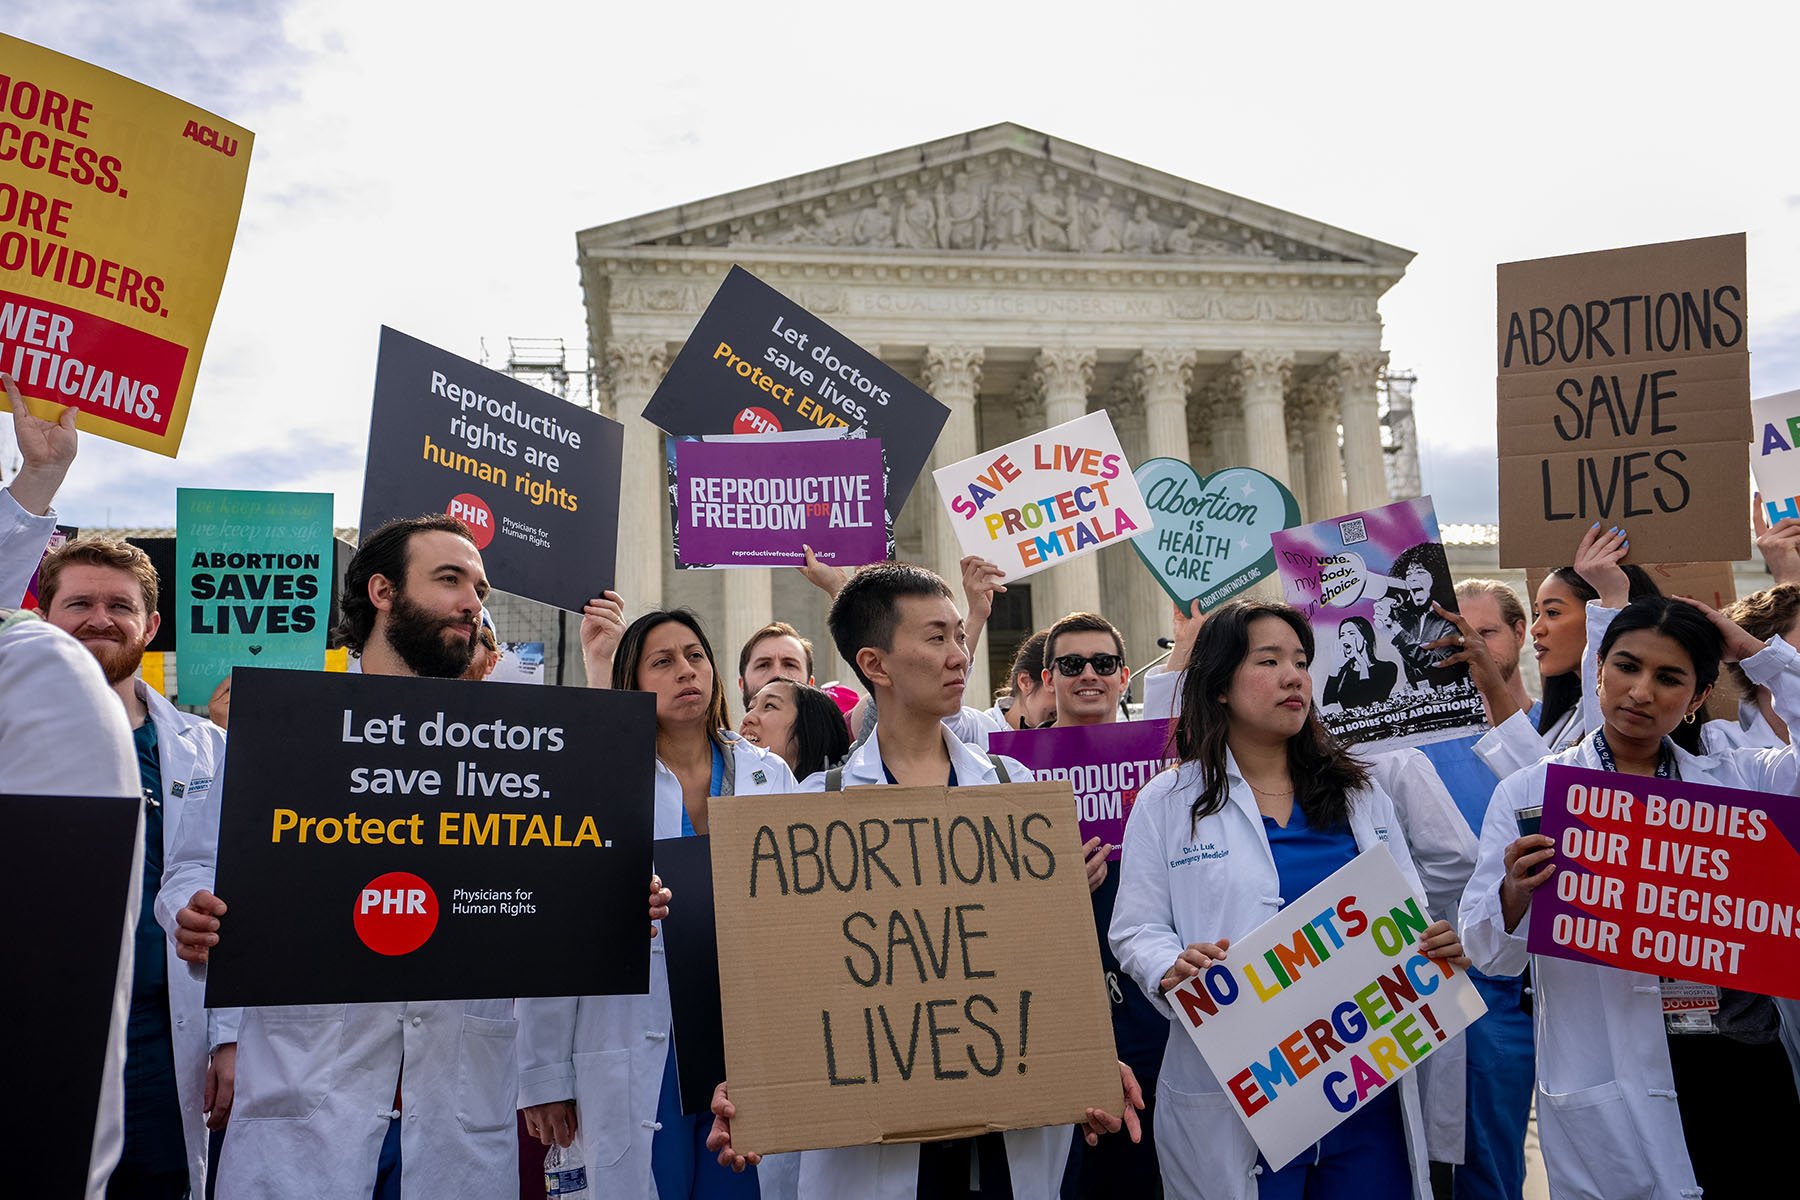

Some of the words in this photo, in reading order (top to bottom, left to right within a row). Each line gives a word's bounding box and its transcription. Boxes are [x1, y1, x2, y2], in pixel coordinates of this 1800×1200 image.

[182, 119, 238, 158] ACLU
[1504, 285, 1743, 368] ABORTIONS
[712, 342, 795, 406] Protect
[771, 316, 809, 352] Let
[811, 345, 892, 407] doctors
[763, 346, 814, 387] save
[818, 376, 869, 426] lives.
[1554, 369, 1677, 441] SAVE
[431, 370, 582, 449] Reproductive
[450, 416, 518, 457] rights
[524, 448, 560, 473] are
[423, 435, 507, 487] human
[514, 473, 578, 512] rights
[690, 475, 871, 504] REPRODUCTIVE
[952, 454, 1022, 520] SAVE
[1034, 444, 1120, 480] LIVES
[1541, 449, 1690, 521] LIVES
[450, 499, 489, 528] PHR
[691, 502, 807, 531] FREEDOM
[806, 503, 830, 518] FOR
[829, 502, 872, 528] ALL
[984, 480, 1110, 541] PROTECT
[1146, 477, 1257, 526] Abortion
[190, 522, 215, 537] we
[219, 519, 262, 539] keep
[265, 525, 286, 538] us
[289, 521, 322, 540] safe
[502, 516, 537, 535] Physicians
[538, 528, 549, 538] for
[502, 526, 528, 541] Human
[529, 534, 550, 548] Rights
[1017, 507, 1137, 568] EMTALA
[1159, 530, 1231, 560] HEALTH
[1189, 519, 1204, 533] IS
[192, 552, 319, 569] ABORTION
[1165, 556, 1213, 582] CARE
[1282, 551, 1313, 568] my
[1315, 555, 1350, 565] vote.
[1295, 576, 1316, 591] my
[1319, 567, 1355, 583] body.
[191, 573, 318, 600] SAVES
[1200, 567, 1261, 609] ABORTIONFINDER.ORG
[1303, 600, 1318, 621] ur
[1320, 577, 1360, 605] choice.
[191, 605, 316, 634] LIVES
[342, 709, 405, 745] Let
[418, 711, 565, 752] doctors
[1345, 717, 1381, 732] BODIES
[350, 767, 441, 795] save
[456, 762, 550, 799] lives.
[271, 809, 424, 845] Protect
[438, 812, 613, 848] EMTALA.
[1566, 784, 1634, 823] OUR
[1645, 794, 1768, 841] BODIES
[749, 812, 1056, 898] ABORTIONS
[1561, 827, 1630, 866] OUR
[1640, 838, 1730, 881] LIVES
[360, 888, 427, 915] PHR
[452, 903, 497, 914] Human
[500, 902, 537, 916] Rights
[453, 888, 513, 903] Physicians
[515, 888, 533, 900] for
[1557, 870, 1625, 910] OUR
[1636, 882, 1800, 940] DECISION
[842, 903, 996, 987] SAVE
[1174, 964, 1239, 1028] NO
[1242, 895, 1368, 1004] LIMITS
[1371, 896, 1429, 957] ON
[1552, 914, 1621, 954] OUR
[1631, 926, 1745, 975] COURT
[821, 990, 1032, 1087] LIVES!
[1226, 950, 1455, 1118] EMERGENCY
[1322, 1003, 1447, 1113] CARE!
